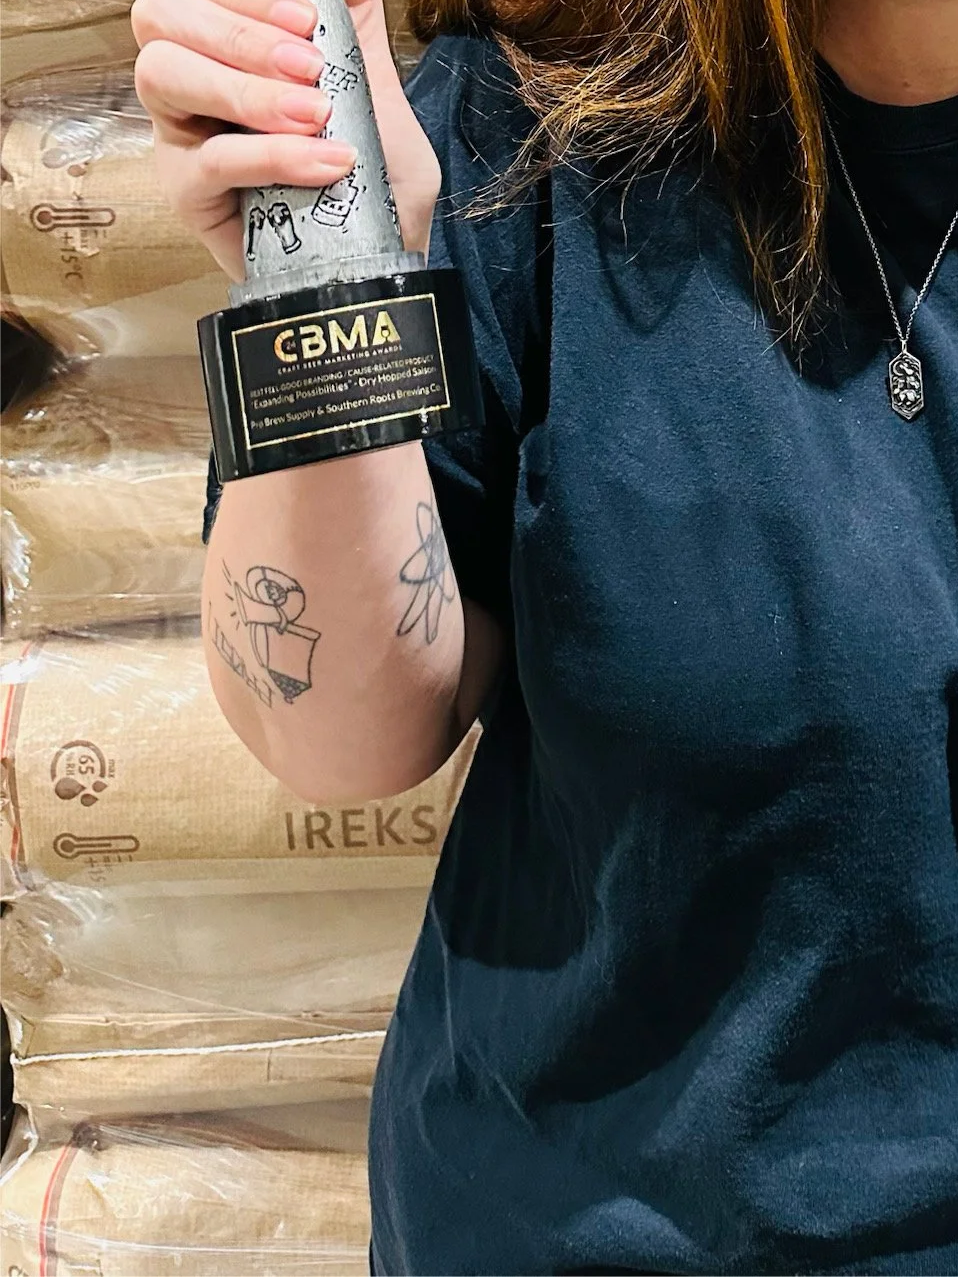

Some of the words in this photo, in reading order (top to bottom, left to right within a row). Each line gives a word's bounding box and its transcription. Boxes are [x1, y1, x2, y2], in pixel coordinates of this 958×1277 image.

[274, 311, 401, 363] CBMA
[303, 371, 343, 386] BRANDING
[347, 360, 405, 377] CAUSE-RELATED
[404, 354, 434, 365] PRODUCT
[324, 349, 370, 364] MARKETING
[372, 344, 402, 356] AWARDS
[358, 376, 376, 388] Dry
[378, 368, 412, 384] Hopped
[412, 366, 436, 377] Saison
[264, 415, 286, 427] Brew
[286, 409, 316, 422] Supply
[317, 405, 325, 415] &
[326, 397, 368, 414] Southern
[369, 391, 395, 404] Roots
[396, 385, 430, 399] Brewing
[78, 755, 95, 775] 65
[286, 805, 438, 851] IREKS
